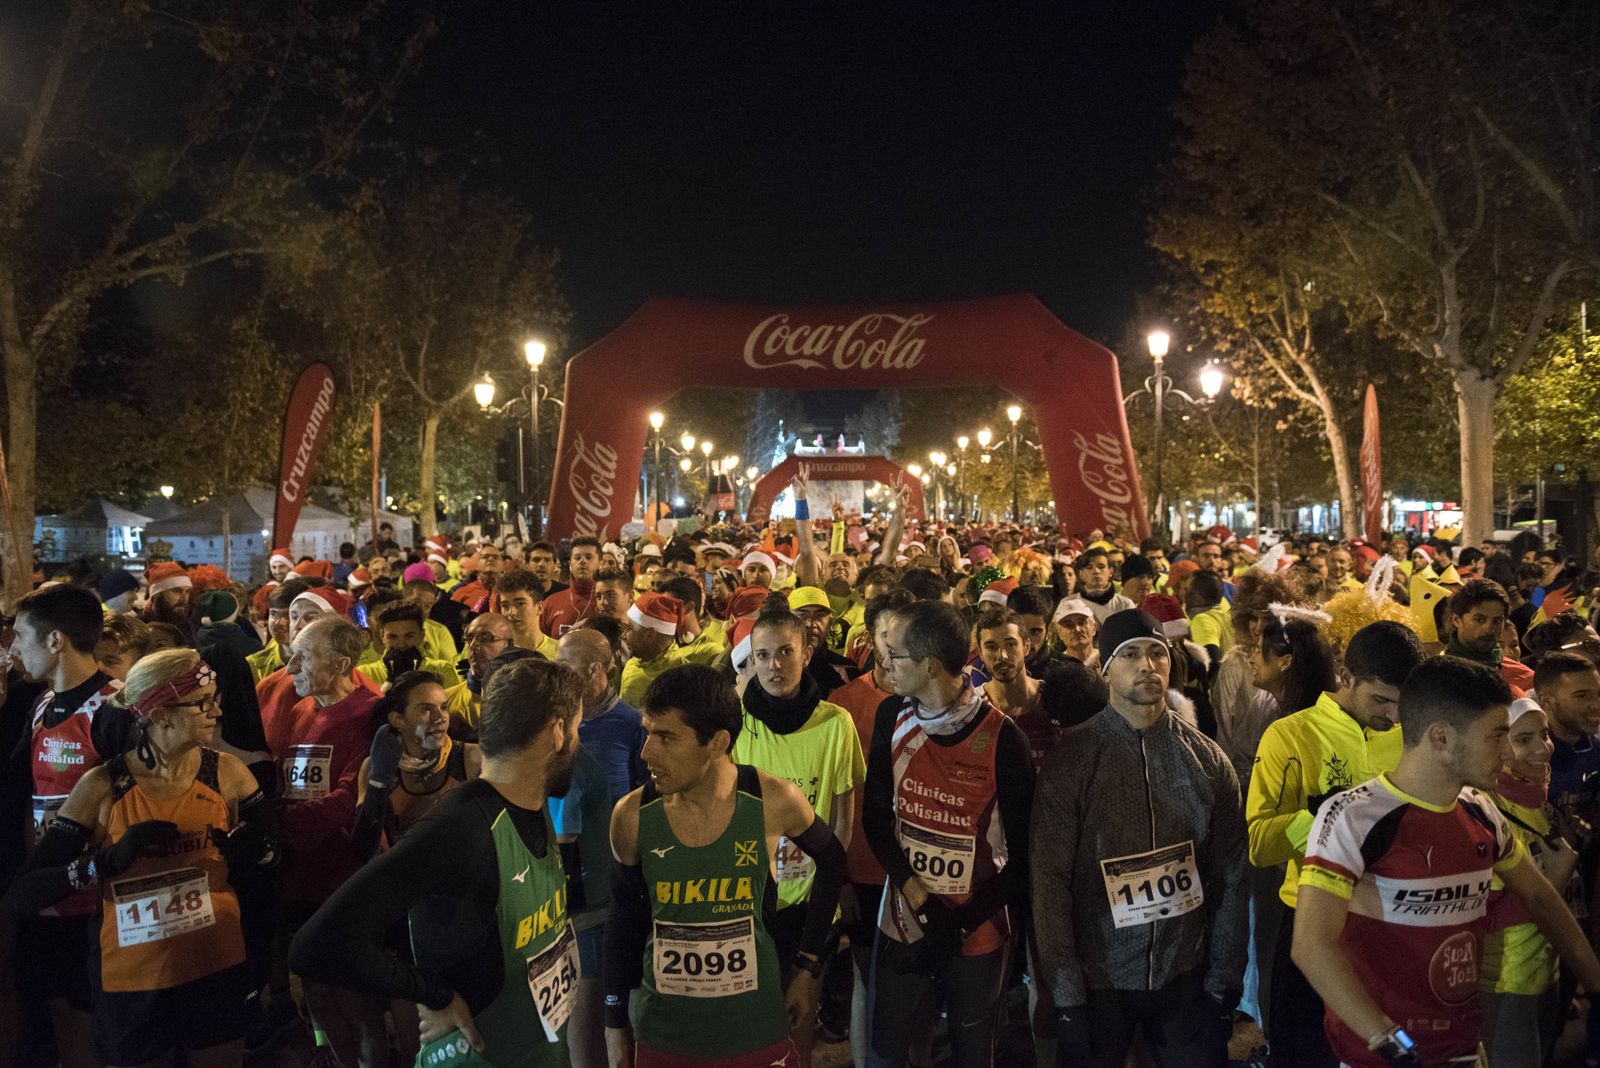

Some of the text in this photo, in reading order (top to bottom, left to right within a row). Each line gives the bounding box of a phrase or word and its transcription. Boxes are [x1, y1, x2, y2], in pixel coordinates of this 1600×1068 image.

[743, 312, 935, 371] Coca-Cola
[282, 377, 335, 503] Cruzcampo
[38, 751, 85, 765] Polisalud
[898, 797, 973, 828] Polisalud
[775, 845, 805, 865] 44
[655, 876, 755, 906] BIKILA
[1118, 868, 1193, 906] 1106
[1394, 880, 1492, 903] ISBILY
[125, 888, 204, 925] 1148
[711, 902, 755, 914] GRANADA
[1392, 898, 1487, 916] TRIATHLO
[661, 947, 748, 976] 2098
